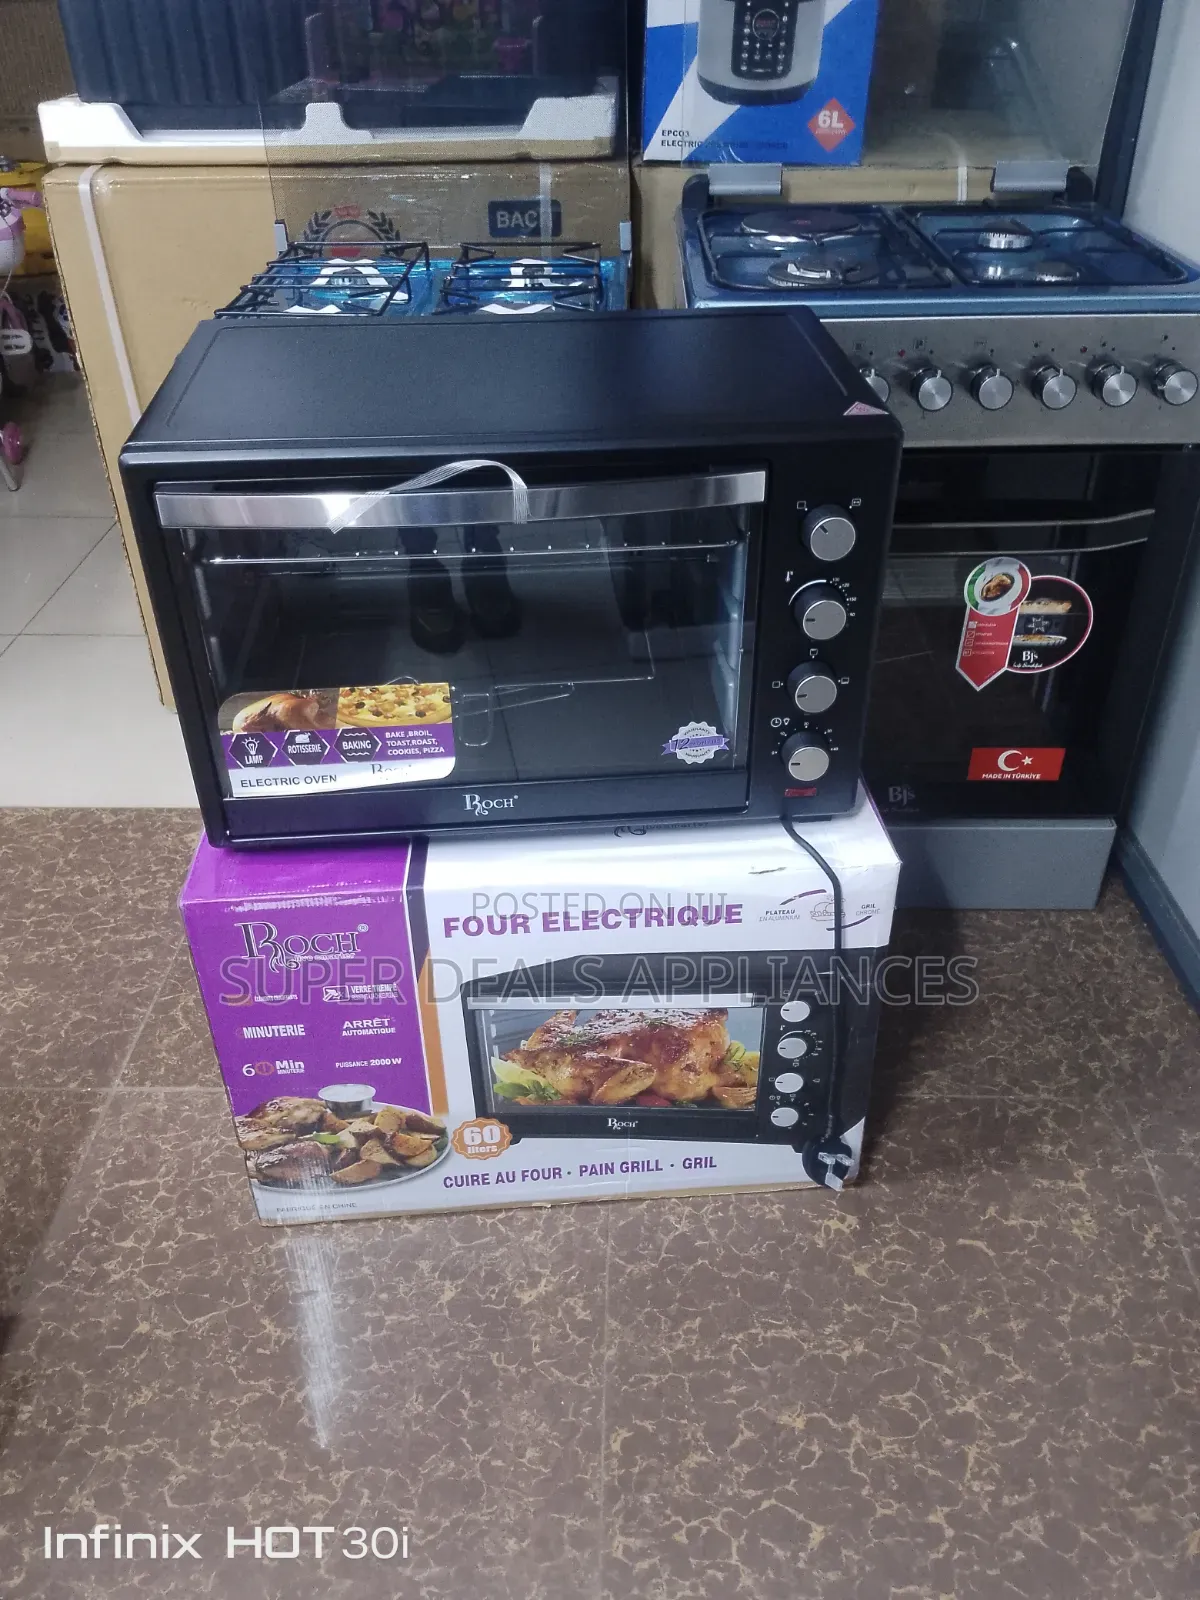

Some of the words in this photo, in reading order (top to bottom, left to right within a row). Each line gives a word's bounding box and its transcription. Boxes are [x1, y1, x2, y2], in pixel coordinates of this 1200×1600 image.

[818, 110, 844, 129] 6L
[385, 731, 405, 739] BAKE
[287, 744, 322, 754] ROTISSERIE
[342, 740, 372, 750] BAKING
[423, 746, 445, 754] PIZZA
[245, 755, 264, 765] LAMP
[240, 776, 301, 788] ELECTRIC
[303, 774, 337, 785] OVEN
[443, 913, 531, 938] FOUR
[542, 903, 743, 933] ELECTRIQUE
[351, 984, 372, 993] VERRE
[343, 1017, 391, 1029] ARRÊT
[242, 1024, 306, 1039] MINUTERIE
[342, 1027, 396, 1037] AUTOMATIQUE
[275, 1059, 305, 1070] Min
[335, 1060, 368, 1069] PUISSANCE
[370, 1058, 391, 1067] 2000
[391, 1057, 402, 1066] W
[462, 1125, 501, 1146] 60
[467, 1144, 498, 1155] liters
[443, 1173, 490, 1189] CUIRE
[495, 1170, 516, 1184] AU
[521, 1167, 563, 1182] FOUR
[579, 1161, 615, 1177] PAIN
[619, 1158, 663, 1174] GRILL
[682, 1156, 717, 1170] GRIL
